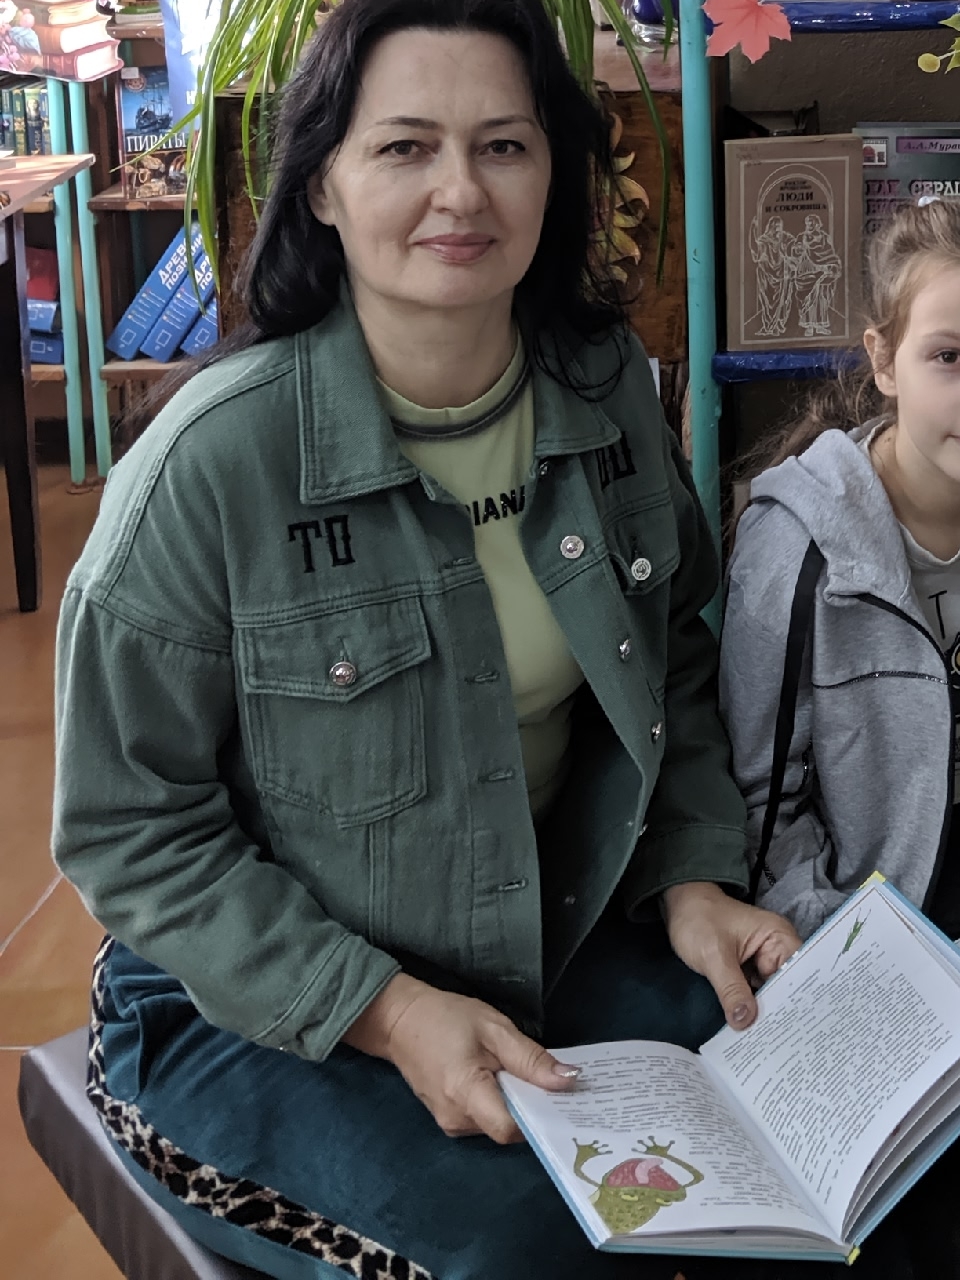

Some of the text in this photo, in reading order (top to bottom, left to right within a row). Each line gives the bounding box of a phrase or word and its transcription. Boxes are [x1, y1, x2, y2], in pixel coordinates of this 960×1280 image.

[866, 180, 901, 196] КАК
[776, 192, 814, 203] ЛЮДИ
[773, 203, 828, 213] СОКРОВИЩА
